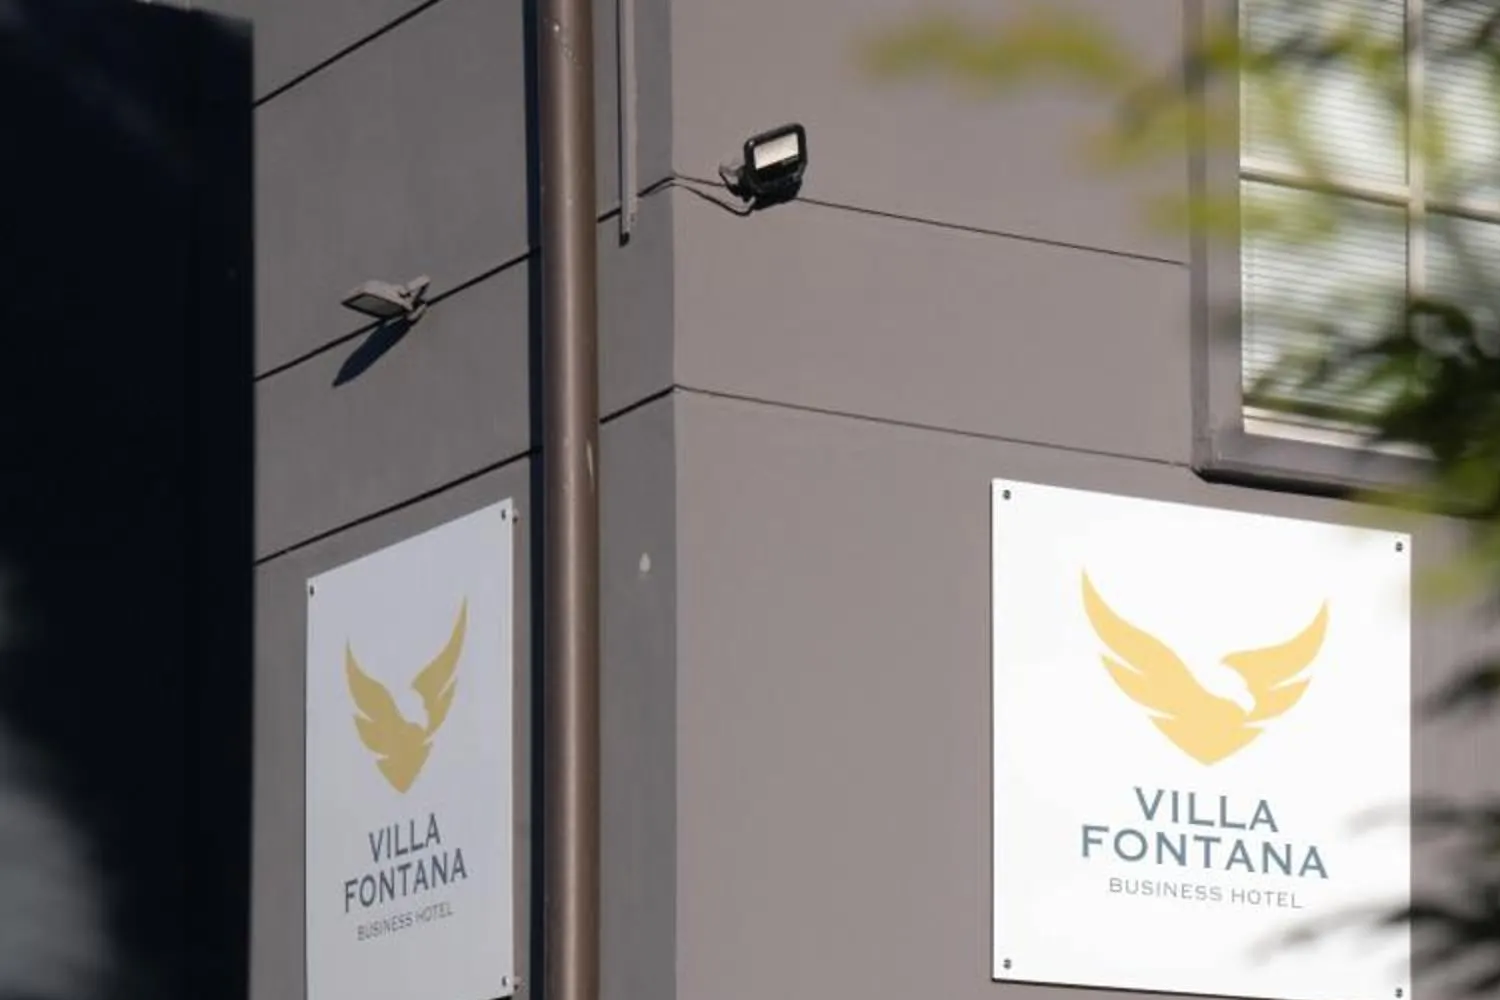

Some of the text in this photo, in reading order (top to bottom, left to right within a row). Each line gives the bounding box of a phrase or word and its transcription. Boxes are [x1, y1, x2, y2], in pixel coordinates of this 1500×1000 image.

[1134, 786, 1279, 833] VILLA
[369, 812, 441, 863] VILLA
[1081, 824, 1329, 879] FONTANA
[344, 848, 468, 914] FONTANA
[1109, 877, 1303, 909] BUSINESS HOTEL
[357, 901, 453, 941] BUSINESS HOTEL
